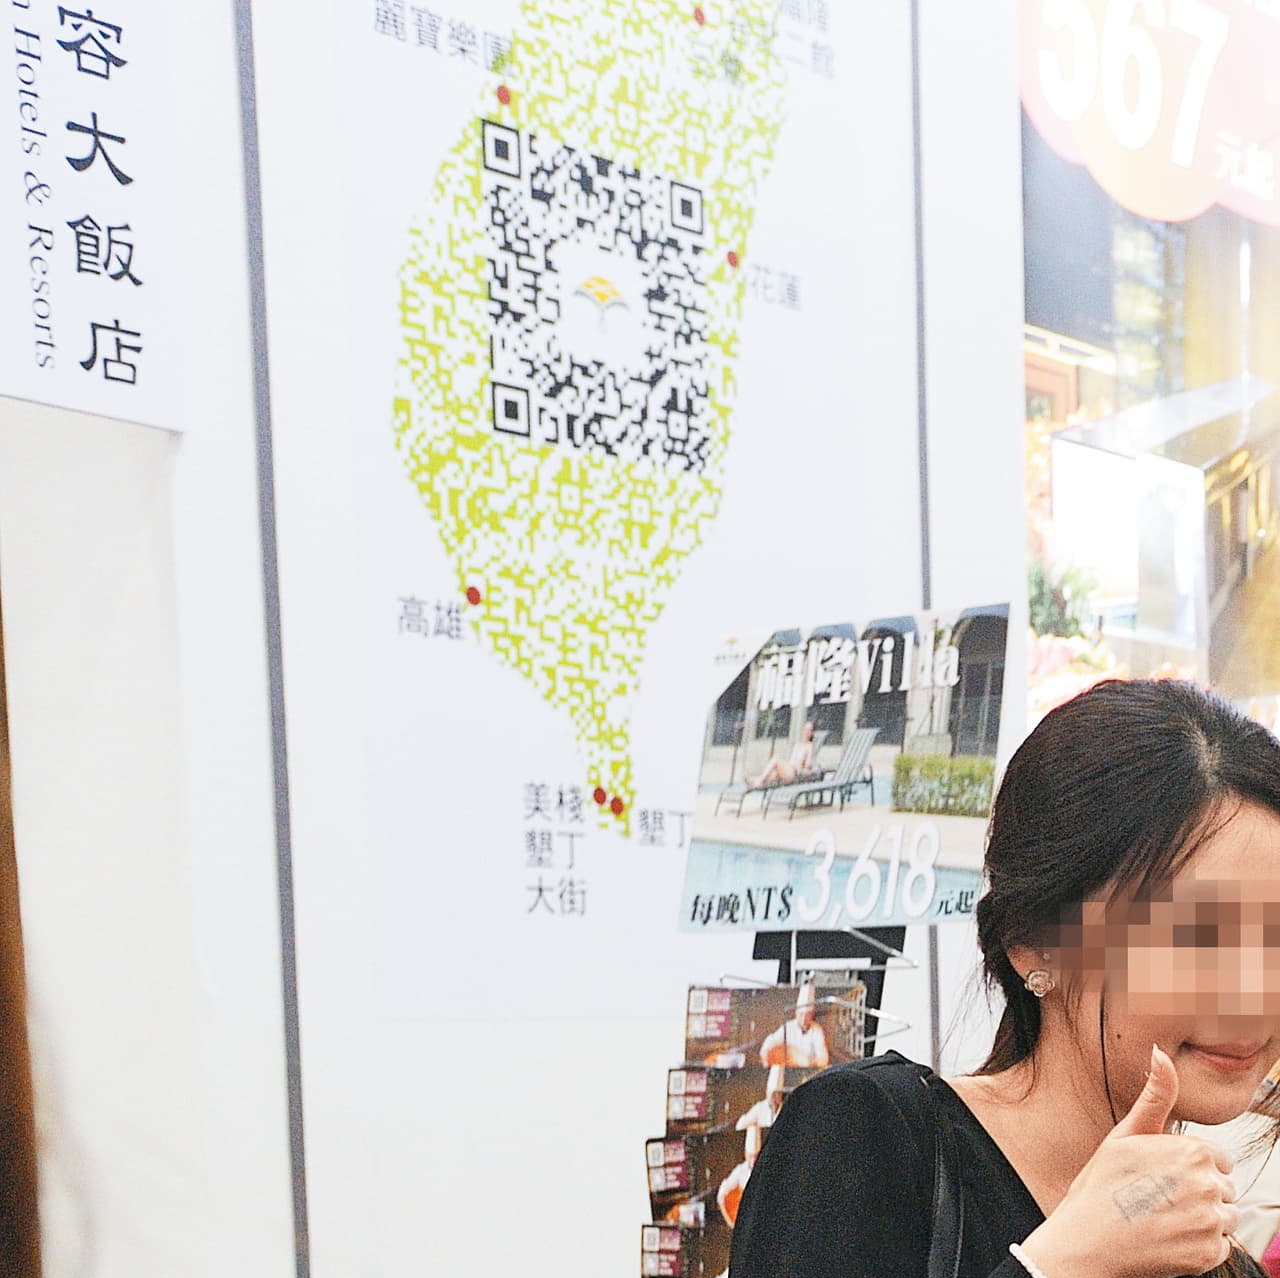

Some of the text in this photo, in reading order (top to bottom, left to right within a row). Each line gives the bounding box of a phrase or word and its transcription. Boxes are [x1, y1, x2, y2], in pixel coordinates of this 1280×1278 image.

[13, 27, 47, 156] Hotels
[1038, 0, 1230, 168] 567
[24, 171, 51, 206] &
[56, 5, 143, 385] 容大飯店
[28, 221, 56, 369] Resorts
[397, 594, 465, 642] 高雄
[524, 829, 586, 870] 墾丁
[637, 807, 695, 849] 墾丁
[526, 875, 588, 917] 大街
[799, 821, 941, 929] 3,618
